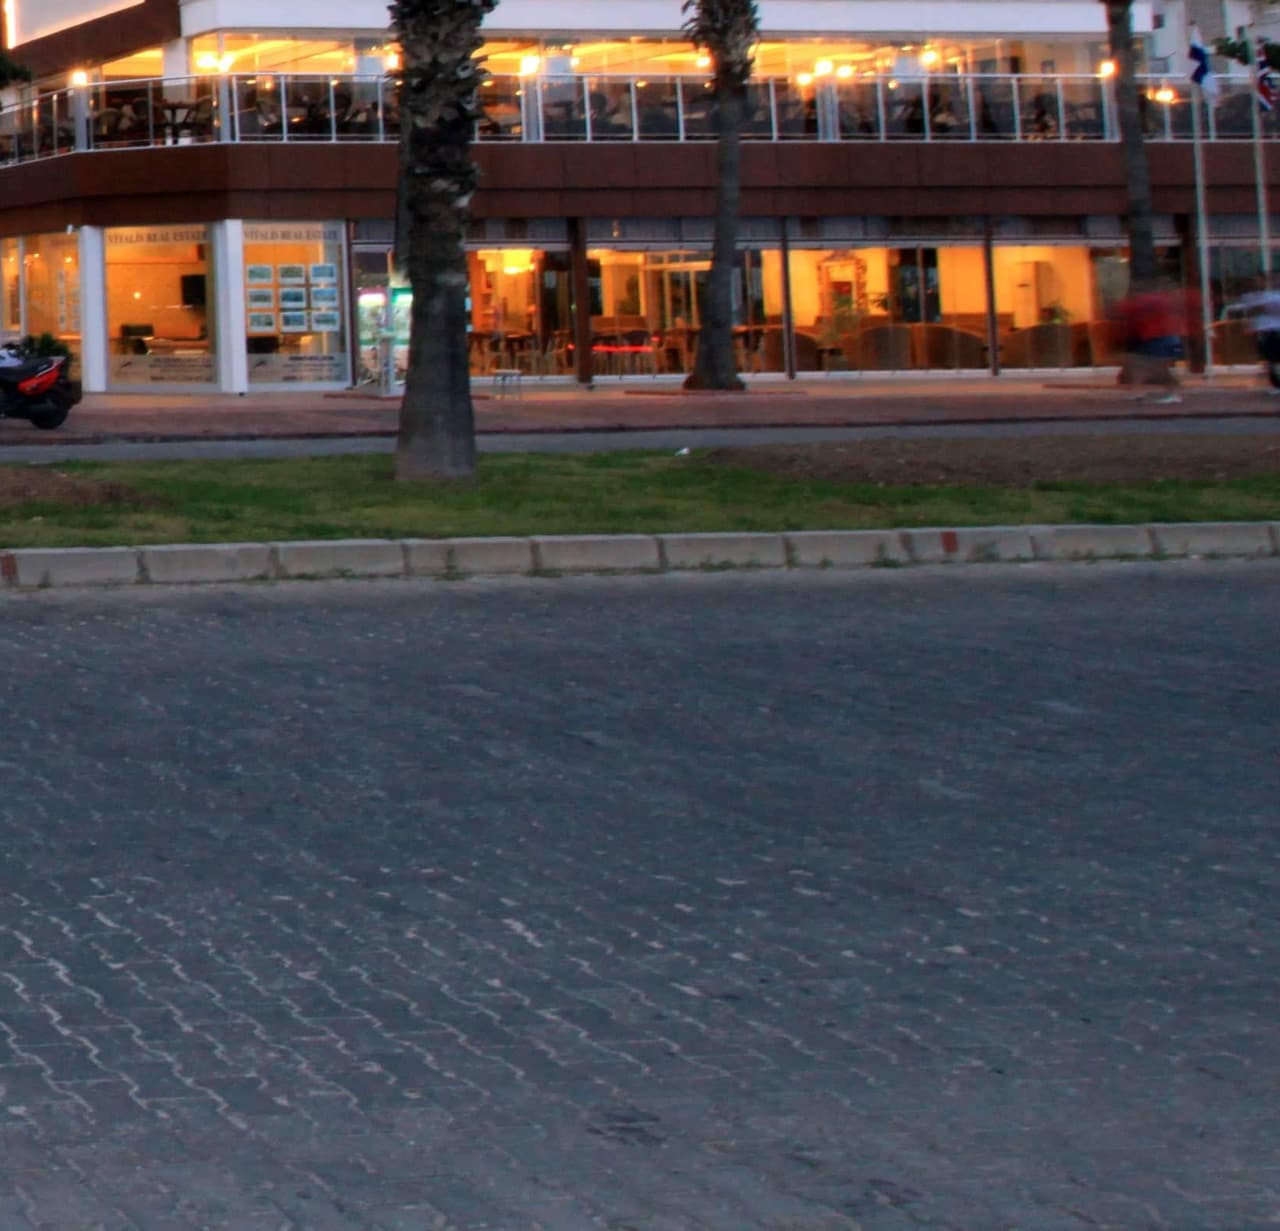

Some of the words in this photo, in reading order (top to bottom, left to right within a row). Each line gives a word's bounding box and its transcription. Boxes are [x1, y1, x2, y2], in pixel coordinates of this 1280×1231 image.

[147, 231, 169, 242] REAL
[173, 230, 207, 242] ESTATE
[280, 230, 302, 241] REAL
[305, 230, 339, 241] ESTATE
